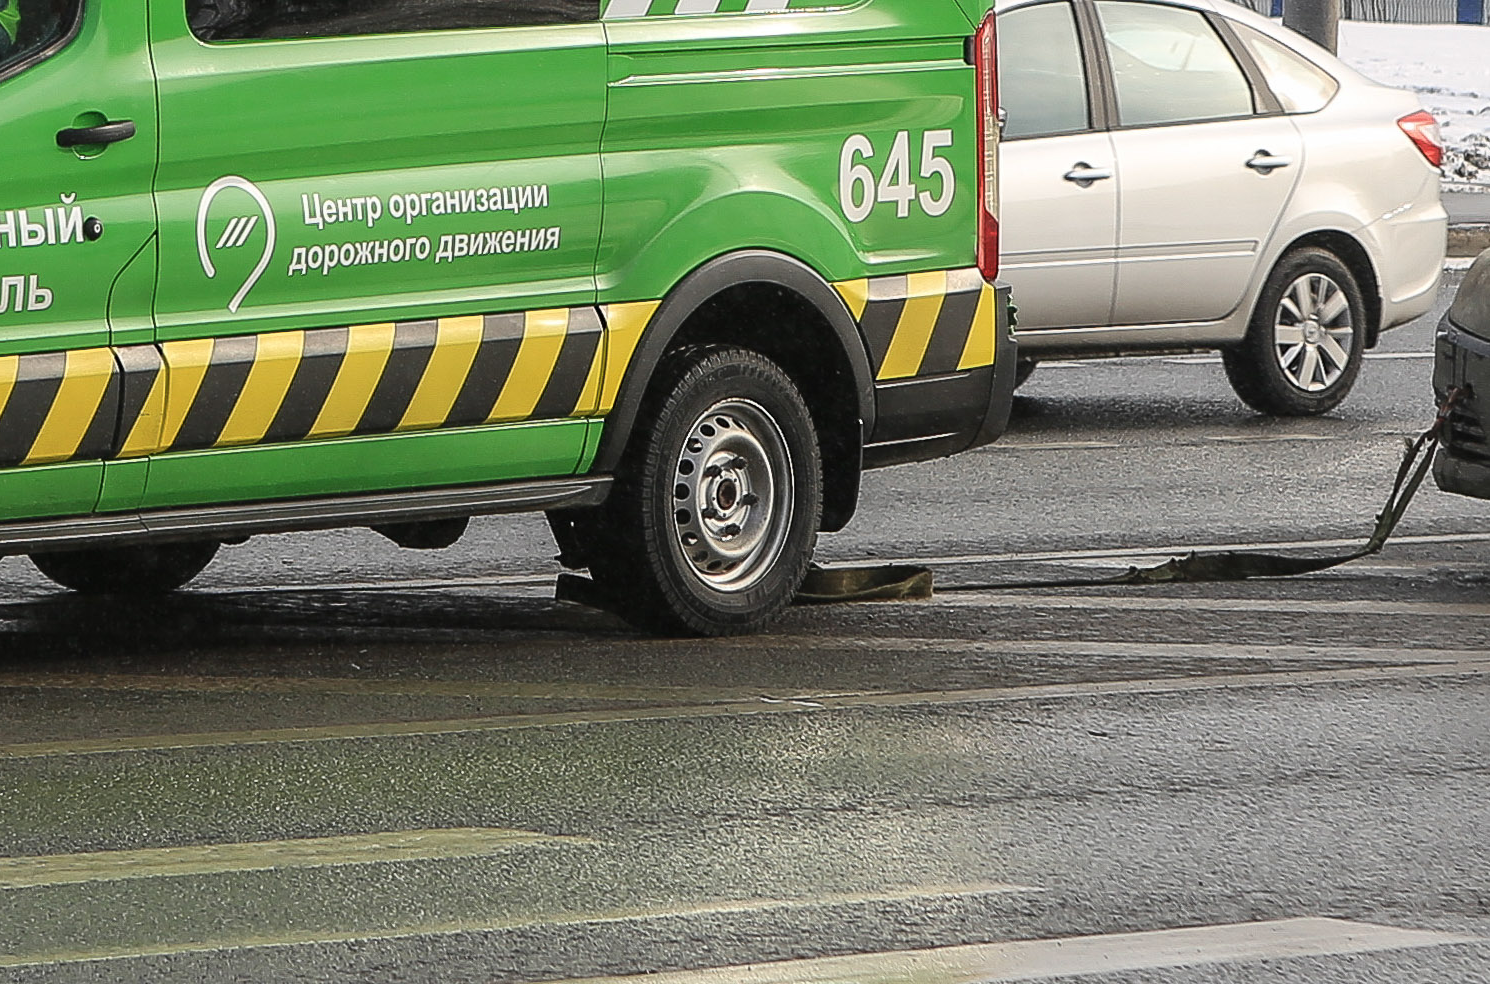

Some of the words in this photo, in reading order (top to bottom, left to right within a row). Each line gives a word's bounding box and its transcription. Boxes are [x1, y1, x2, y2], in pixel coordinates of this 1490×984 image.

[839, 129, 956, 223] 645
[301, 192, 382, 230] Центр
[388, 184, 549, 225] организации
[288, 236, 431, 277] дорожного
[434, 226, 561, 264] движения
